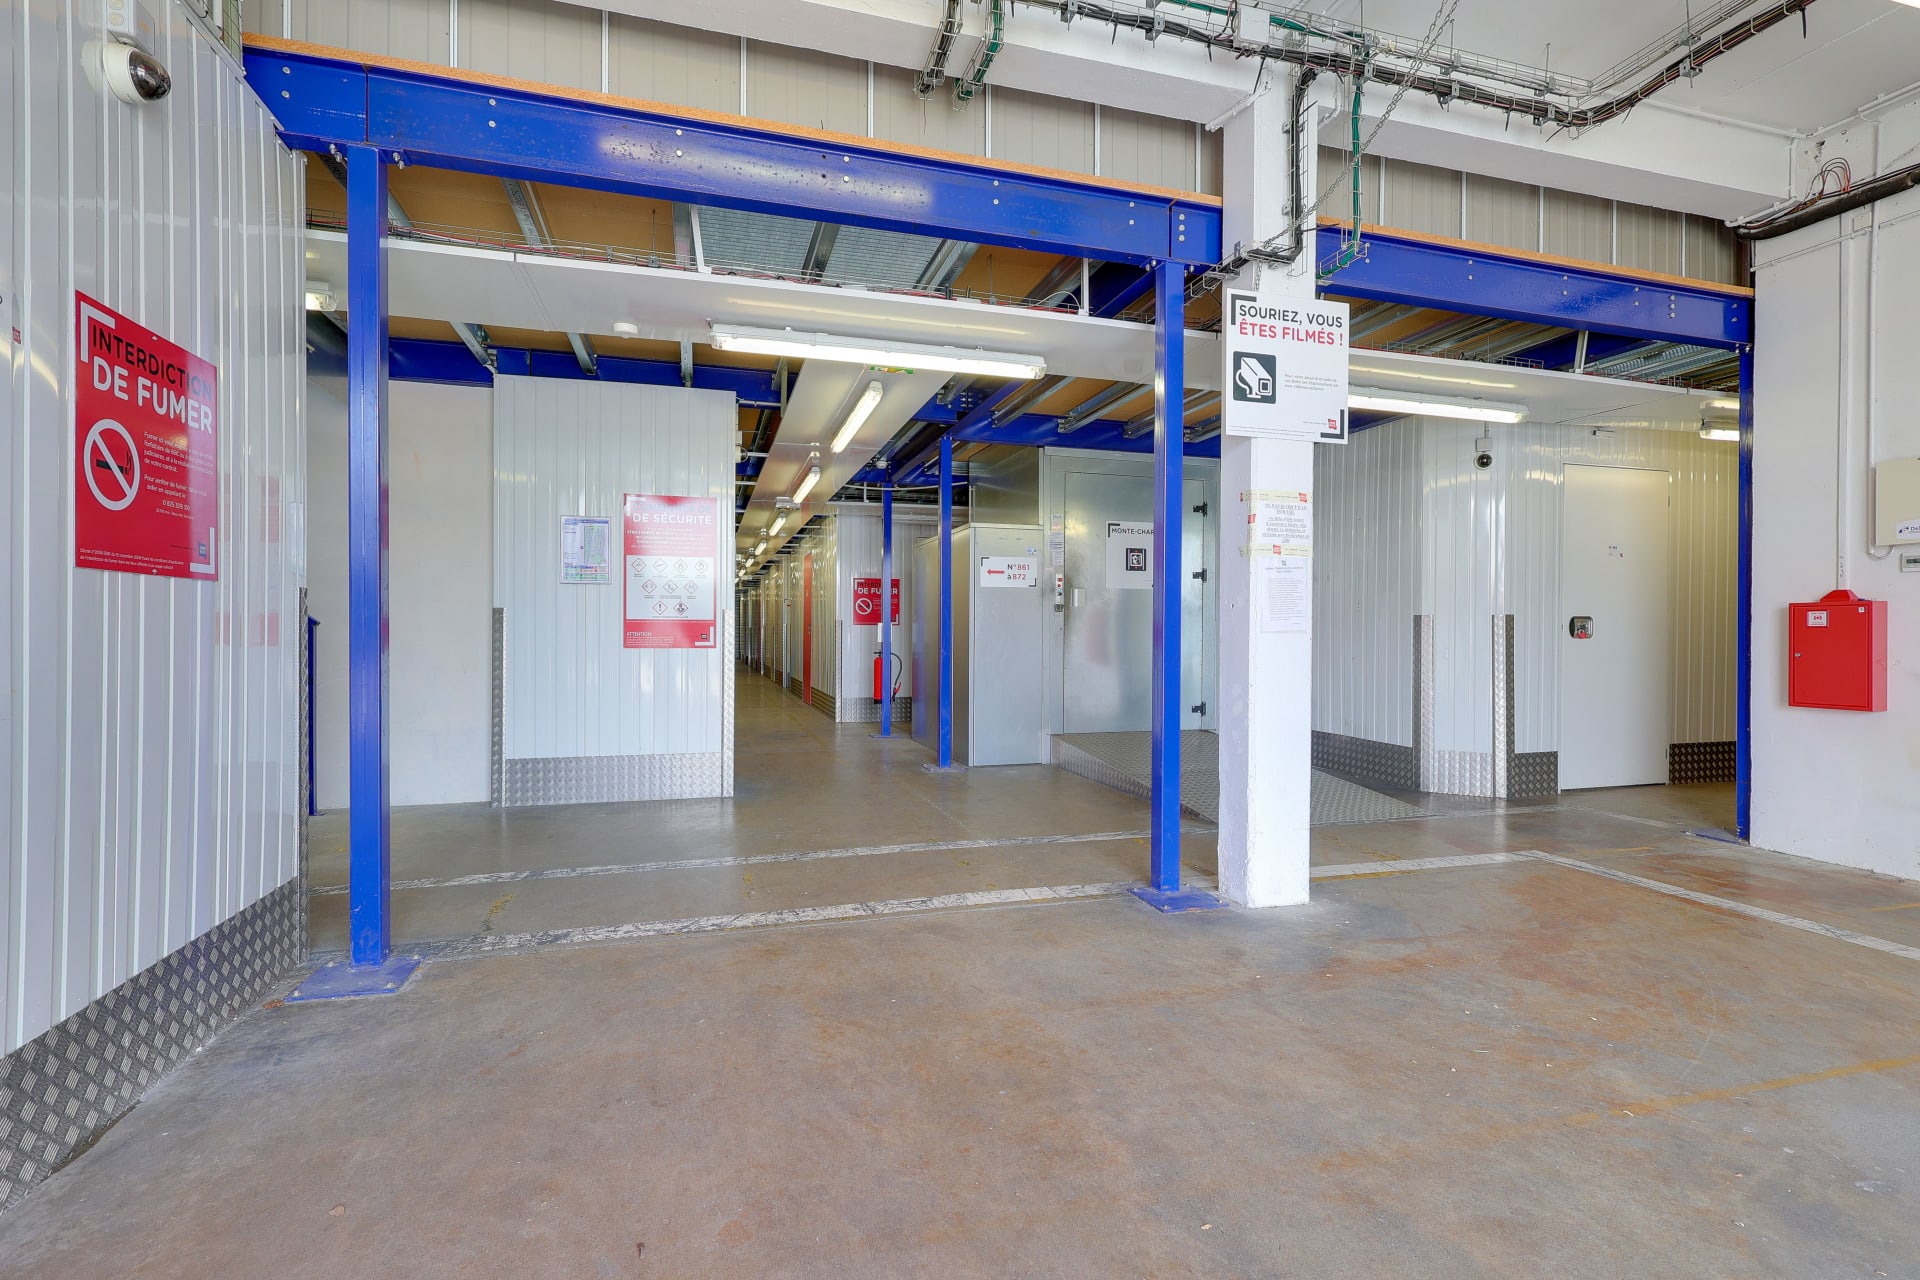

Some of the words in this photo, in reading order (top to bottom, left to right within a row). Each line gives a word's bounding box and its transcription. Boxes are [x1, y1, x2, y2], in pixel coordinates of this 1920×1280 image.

[1239, 304, 1302, 325] SOURIEZ,
[1307, 312, 1343, 328] VOUS
[1240, 318, 1277, 339] ÊTES
[1282, 327, 1335, 345] FILMÉS
[92, 324, 212, 400] INTERDICTION
[93, 355, 129, 401] DE
[138, 376, 213, 434] FUMER
[632, 513, 649, 523] DE
[653, 512, 712, 525] SÉCURITÉ
